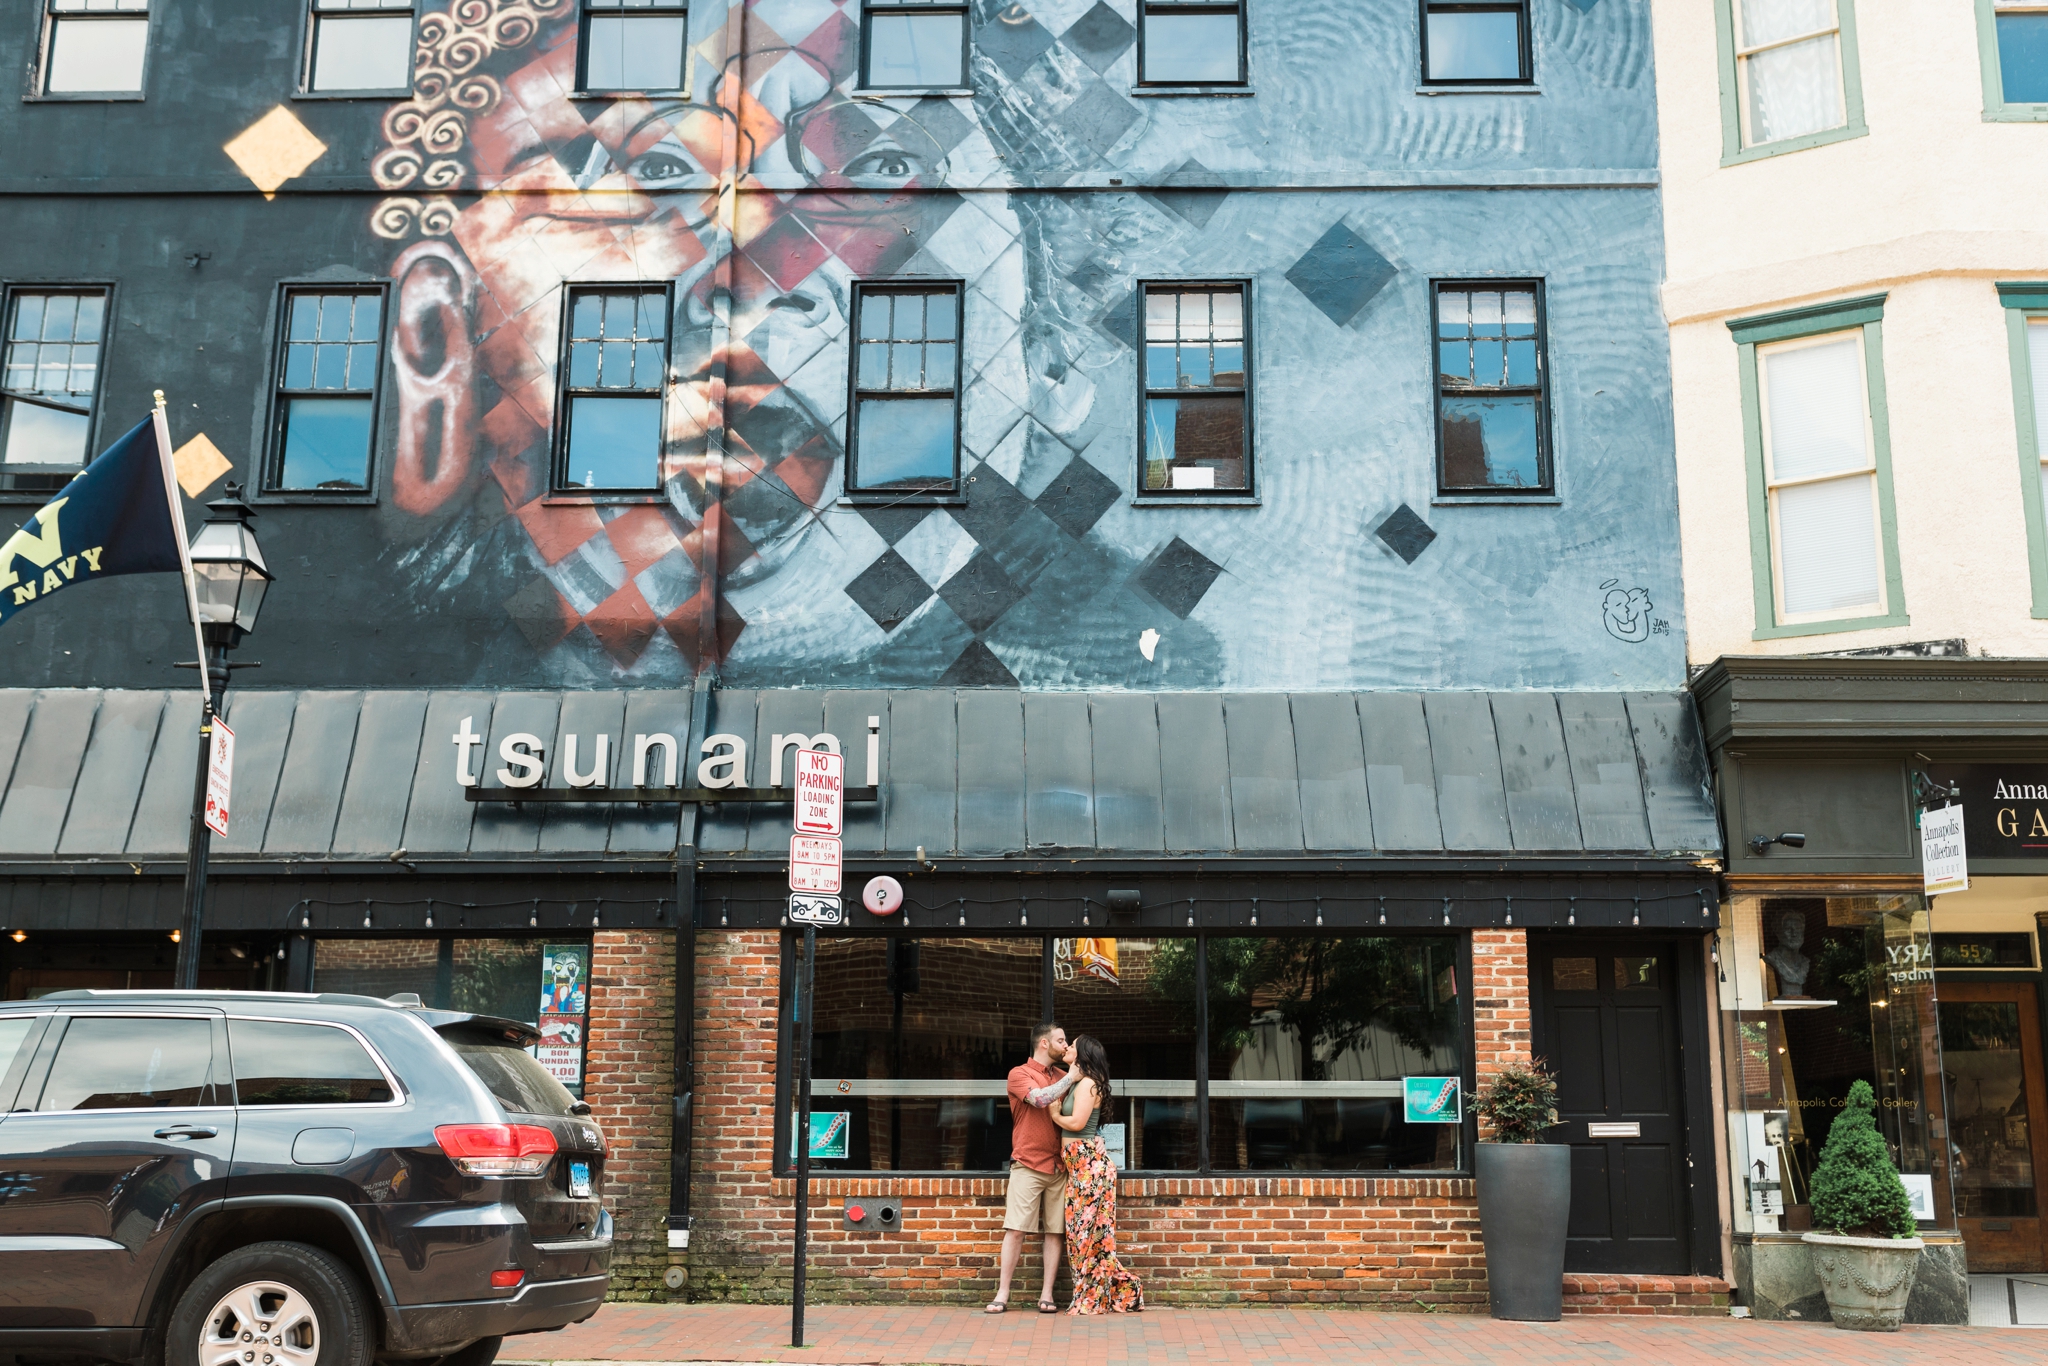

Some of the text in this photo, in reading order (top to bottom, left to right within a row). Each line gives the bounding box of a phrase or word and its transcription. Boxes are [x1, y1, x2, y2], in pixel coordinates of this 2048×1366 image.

[13, 546, 103, 605] NAVY
[452, 716, 879, 788] tsunami
[812, 754, 828, 770] NO
[800, 772, 839, 792] PARKING
[1994, 778, 2048, 800] Anna
[804, 791, 834, 805] LOADING
[810, 806, 828, 818] ZONE
[1924, 818, 1959, 841] Annapolis
[1996, 808, 2048, 837] GA
[801, 840, 832, 850] WEEKDAYS
[1926, 841, 1959, 862] Collection
[797, 851, 836, 861] 8AM TO 5PM
[1928, 864, 1960, 877] GALLERY
[794, 877, 837, 888] 8AM TO 12PM
[1960, 945, 1979, 958] 55
[546, 1067, 575, 1076] 1.00
[1777, 1097, 1826, 1109] Annapolis
[1882, 1097, 1918, 1110] Gallery
